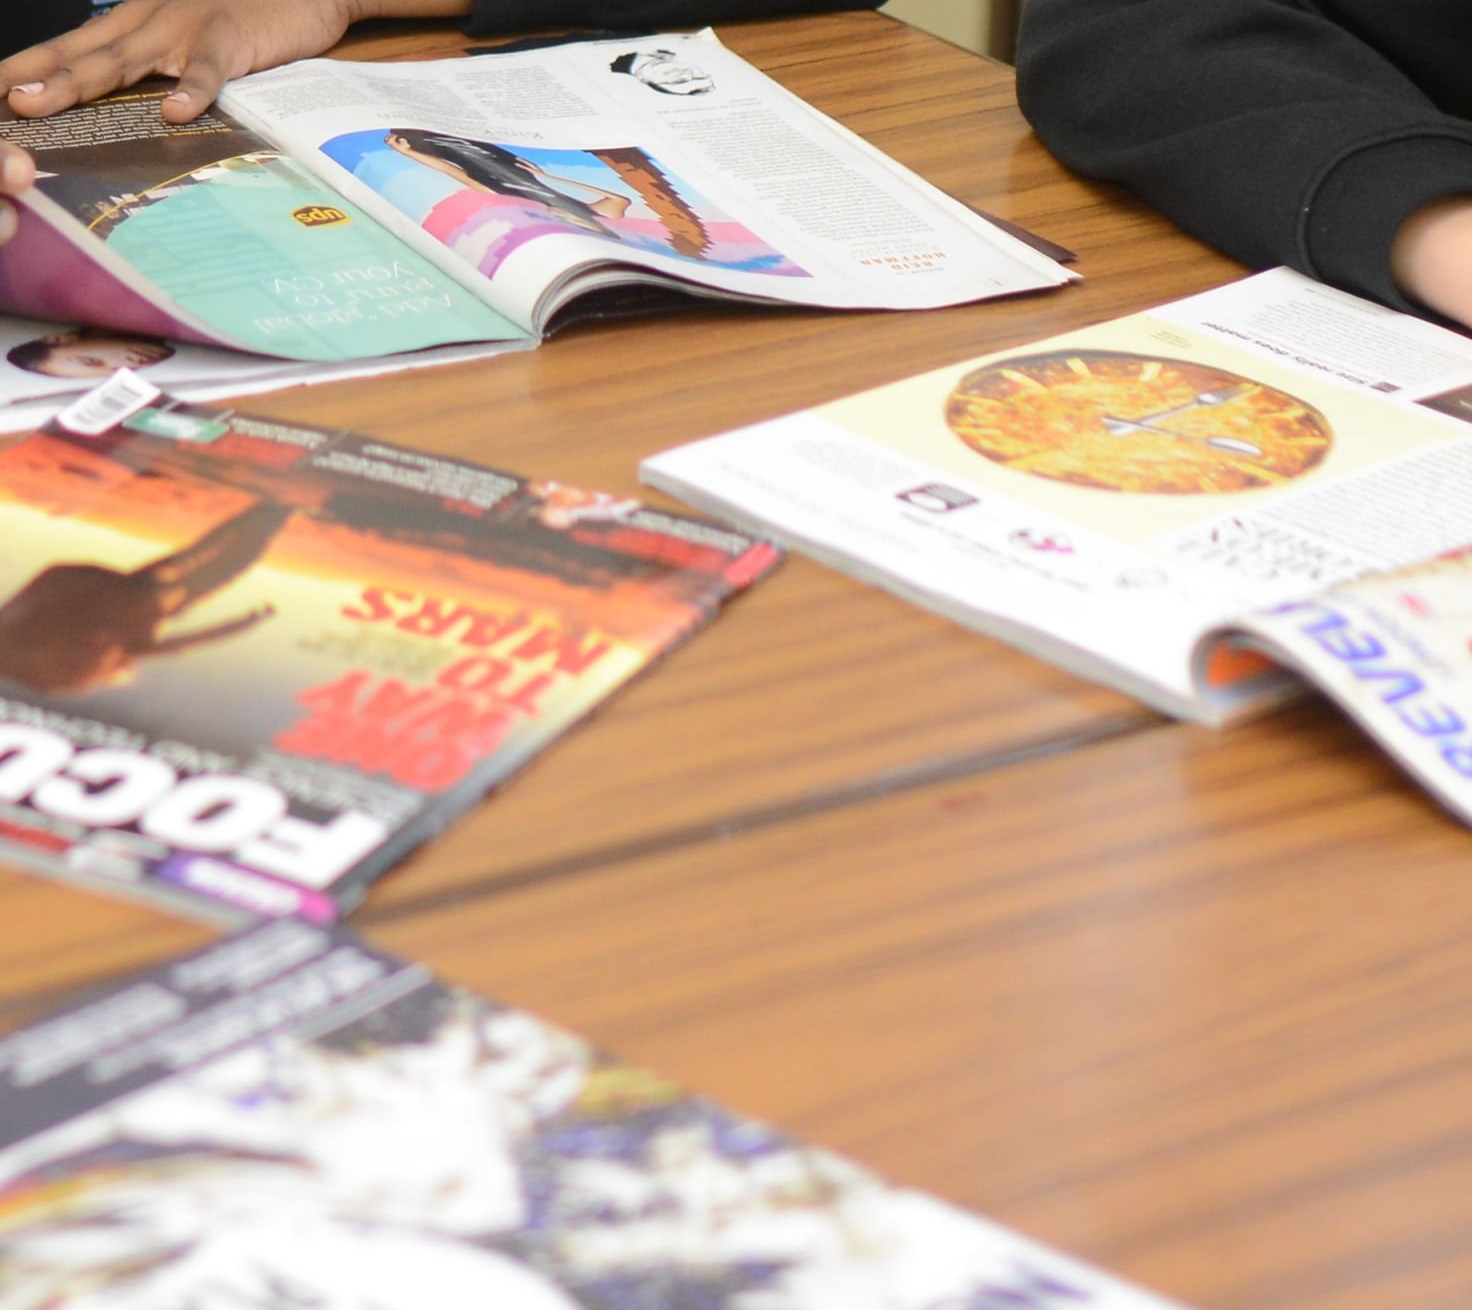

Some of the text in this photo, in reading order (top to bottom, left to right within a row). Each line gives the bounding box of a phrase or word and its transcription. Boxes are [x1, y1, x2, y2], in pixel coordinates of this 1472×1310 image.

[295, 206, 345, 224] ups
[333, 259, 415, 284] your
[378, 293, 453, 317] Add
[341, 586, 618, 679] MARS
[436, 653, 563, 719] TO
